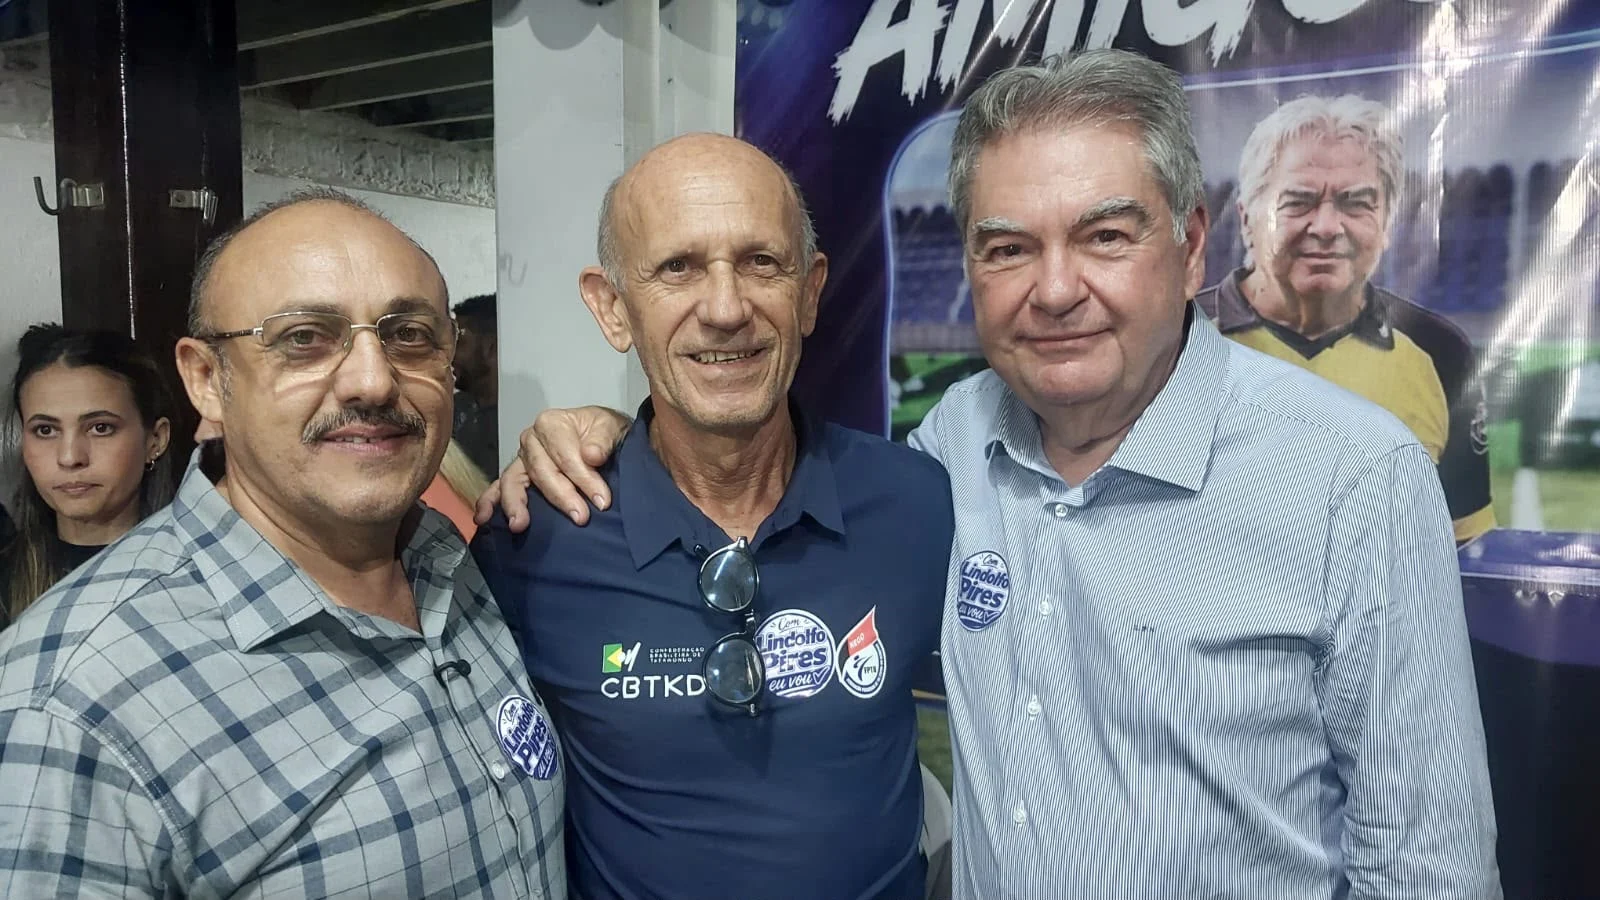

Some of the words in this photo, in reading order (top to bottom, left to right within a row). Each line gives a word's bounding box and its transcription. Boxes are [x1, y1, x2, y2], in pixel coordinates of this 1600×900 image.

[962, 561, 1008, 588] Lindolfo
[961, 577, 1004, 608] Pires
[779, 618, 801, 630] Com
[757, 627, 826, 653] Lindolfo
[601, 674, 706, 699] CBTKD
[769, 679, 786, 691] eu
[789, 673, 811, 688] vou
[518, 715, 547, 772] Pires
